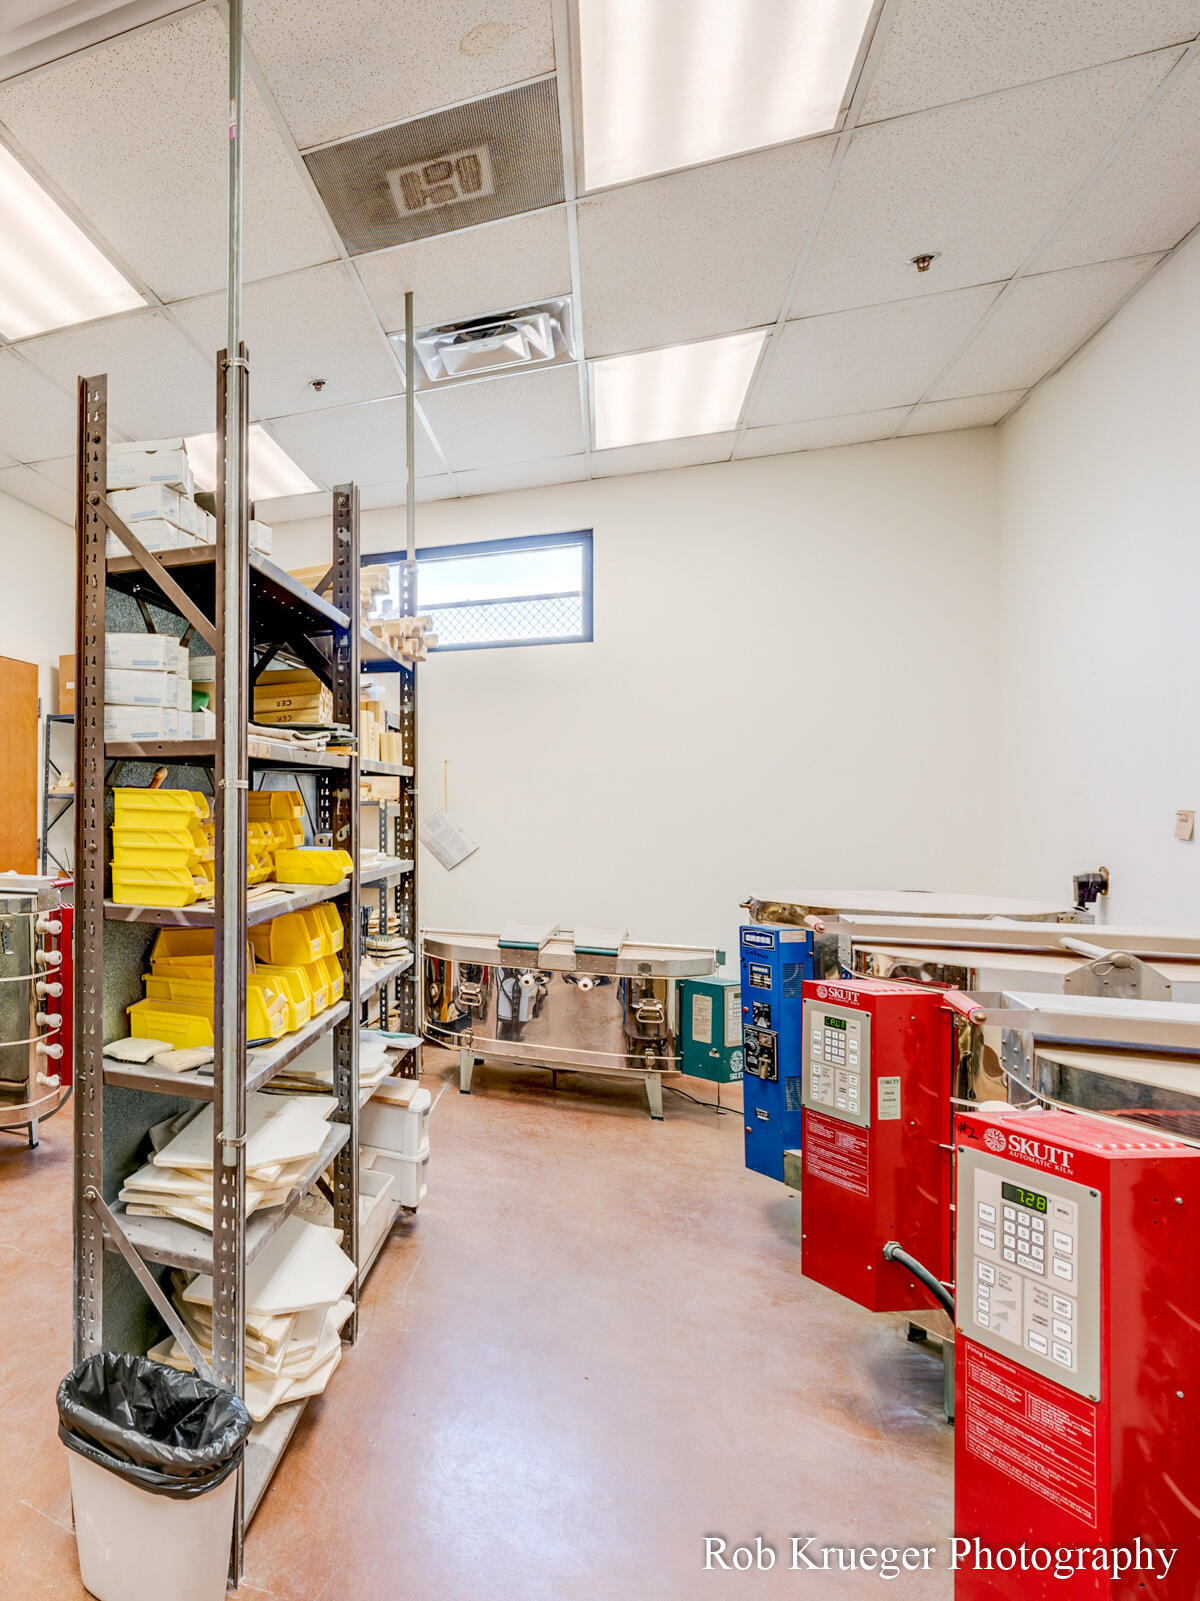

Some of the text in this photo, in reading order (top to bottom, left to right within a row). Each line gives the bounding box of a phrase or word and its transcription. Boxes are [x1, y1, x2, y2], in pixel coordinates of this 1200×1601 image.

[828, 987, 860, 1003] SKUTT
[958, 1121, 979, 1140] #2
[1008, 1134, 1074, 1168] SKUTT
[1009, 1150, 1074, 1176] AUTOMATIC KILN
[1016, 1188, 1046, 1211] 728
[1019, 1255, 1043, 1272] ENTER
